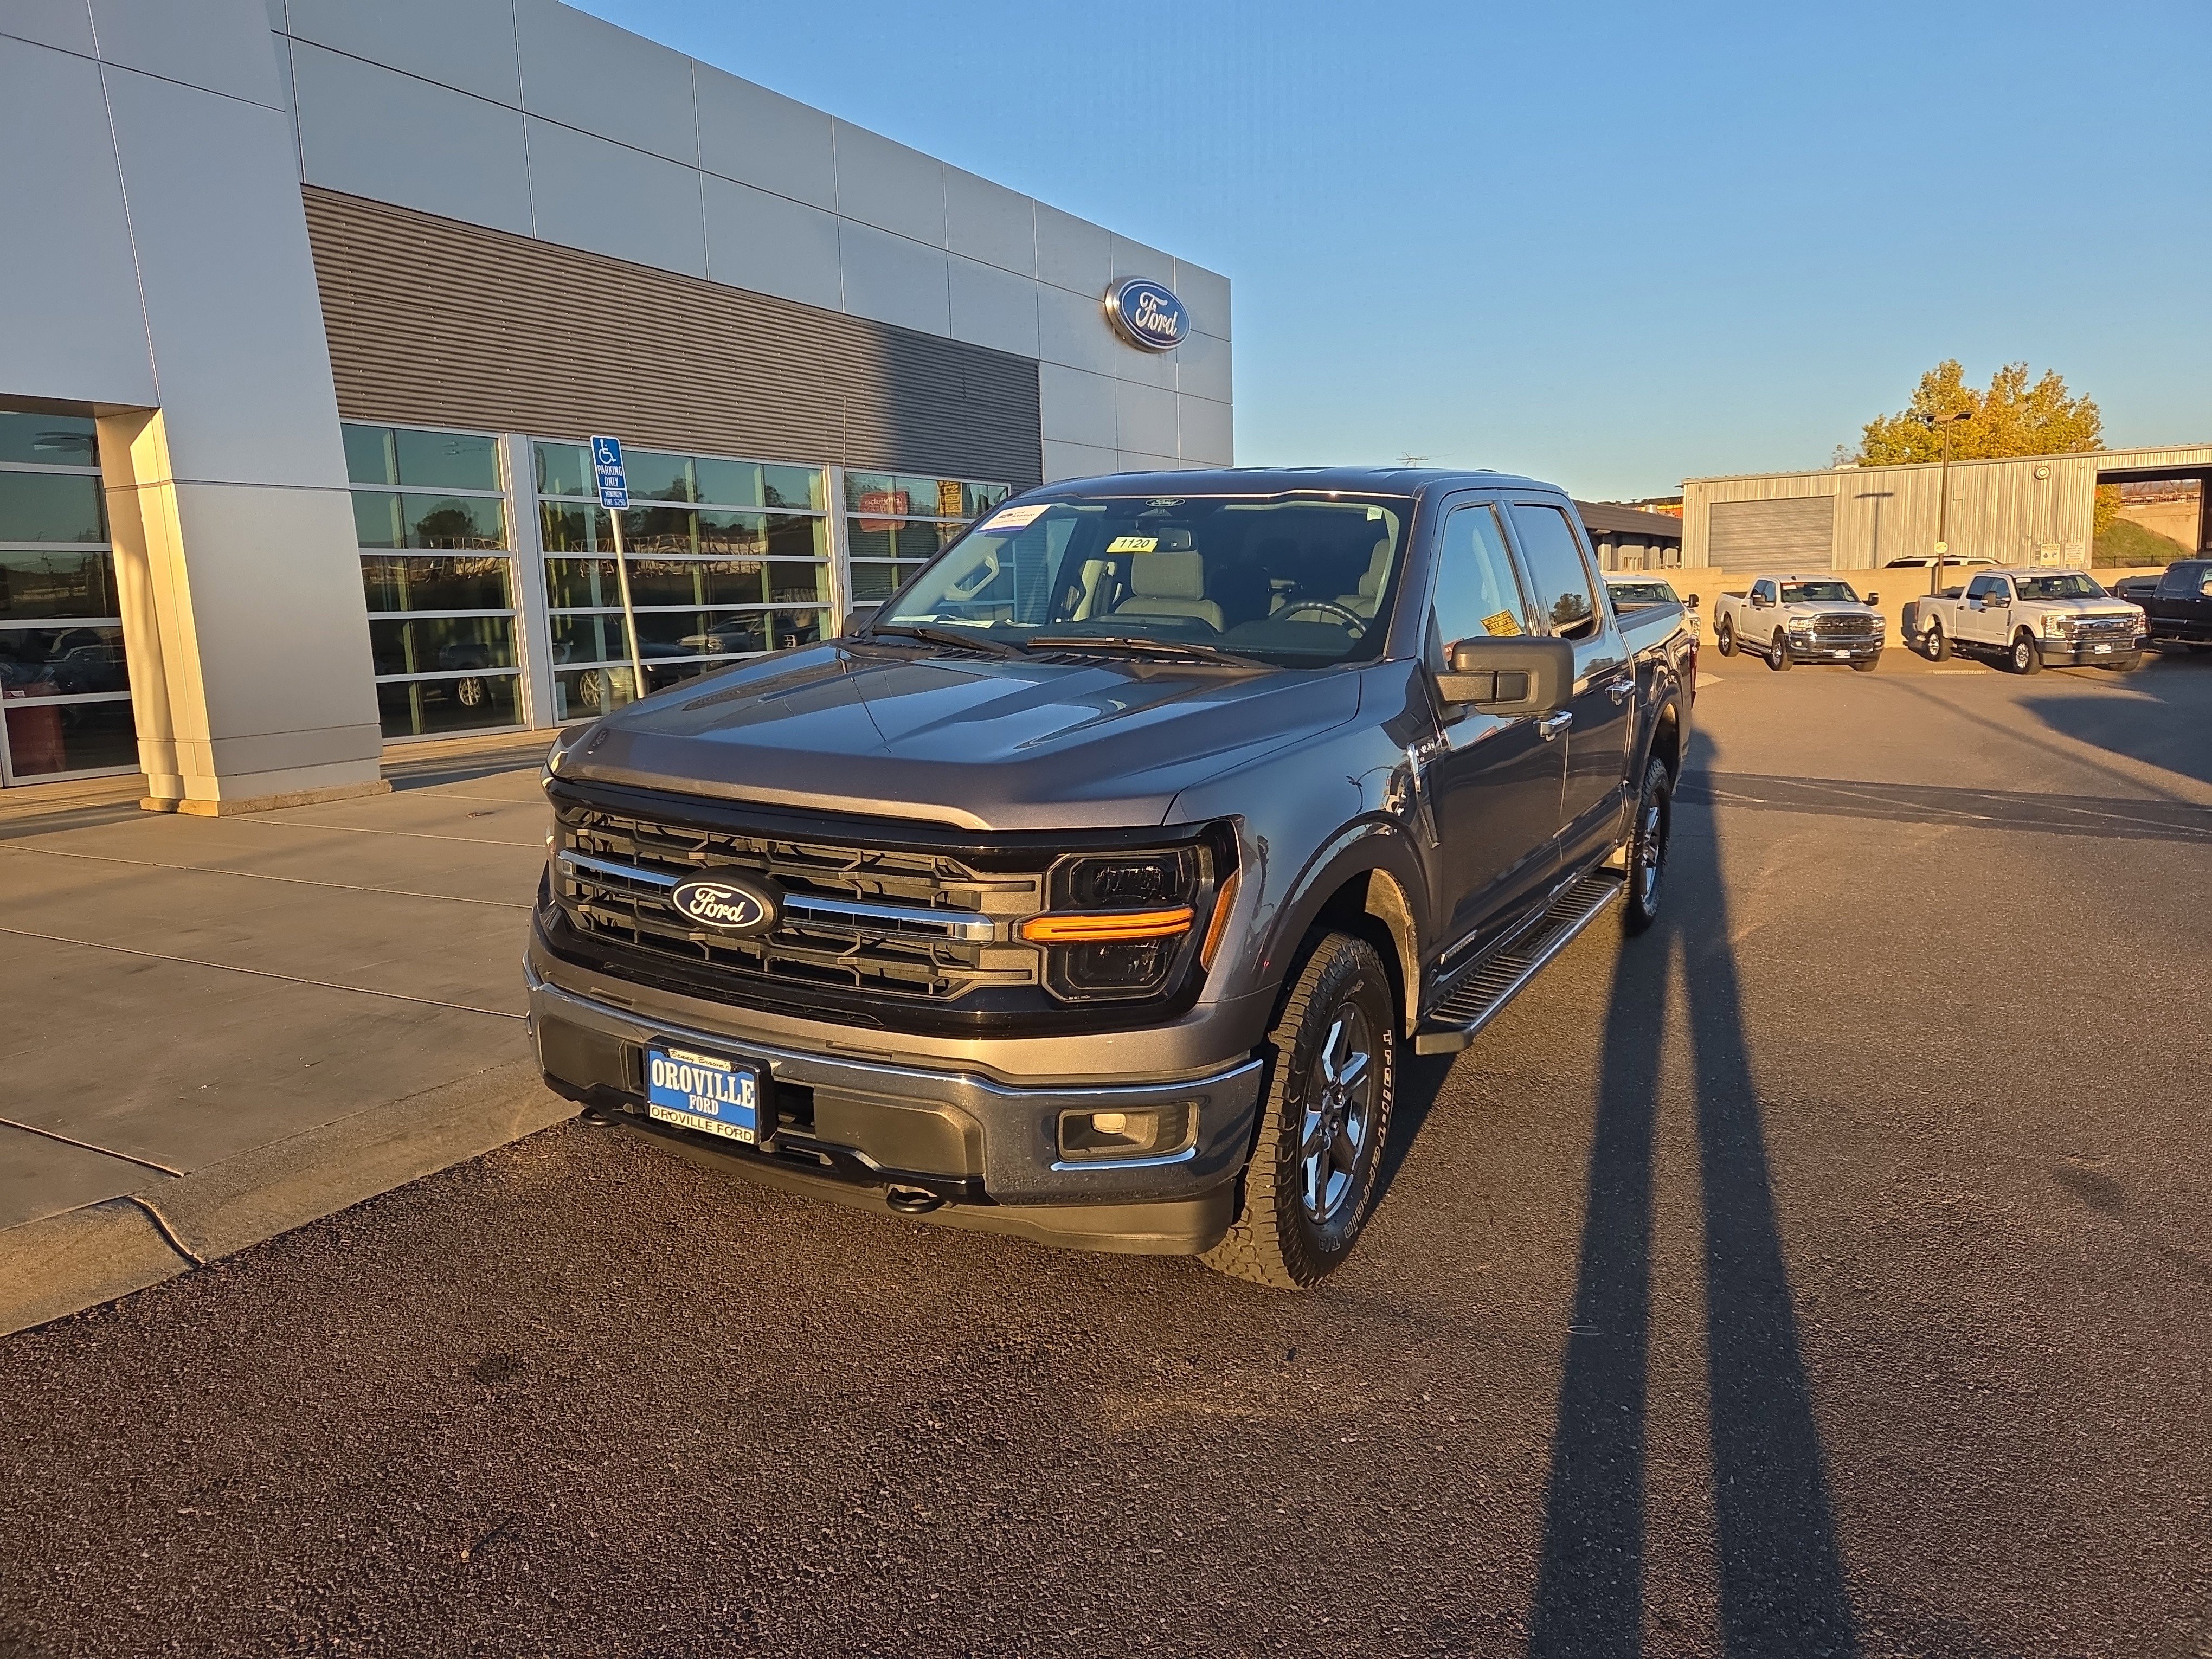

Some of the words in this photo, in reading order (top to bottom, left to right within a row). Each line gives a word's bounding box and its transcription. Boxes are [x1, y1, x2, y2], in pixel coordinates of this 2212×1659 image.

[1136, 292, 1178, 336] Ford
[597, 465, 623, 477] PARKING
[604, 476, 619, 487] ONLY
[1120, 538, 1150, 548] 1120
[690, 887, 746, 922] Ford
[670, 1050, 695, 1063] Benny
[698, 1057, 730, 1070] Brown's
[652, 1059, 755, 1109] OROVILLE
[688, 1094, 719, 1115] FORD
[651, 1107, 712, 1130] OROVILLE
[717, 1123, 752, 1141] FORD
